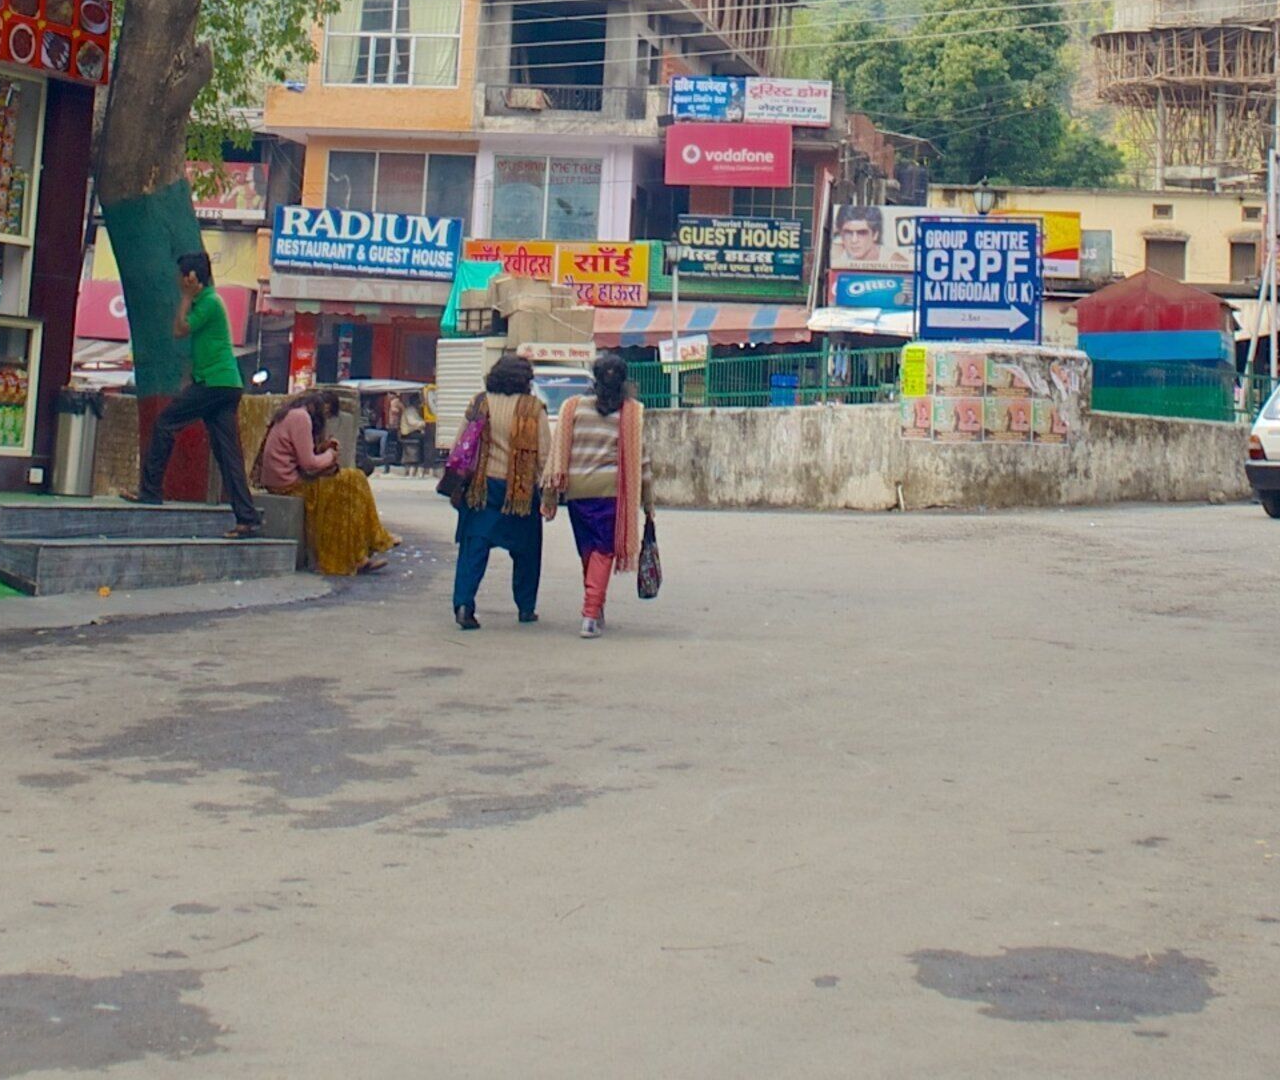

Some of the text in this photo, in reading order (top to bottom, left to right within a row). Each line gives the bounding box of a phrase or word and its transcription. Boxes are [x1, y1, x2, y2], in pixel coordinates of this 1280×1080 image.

[705, 148, 775, 164] vodafone
[280, 206, 452, 247] RADIUM
[679, 226, 800, 249] GUEST HOUSE
[925, 230, 1029, 251] GROUP CENTRE
[276, 238, 454, 268] RESTAURANT & GUEST HOUSE
[926, 249, 1030, 282] CRPF
[848, 279, 898, 297] OREO
[924, 281, 999, 302] KATHGODAM
